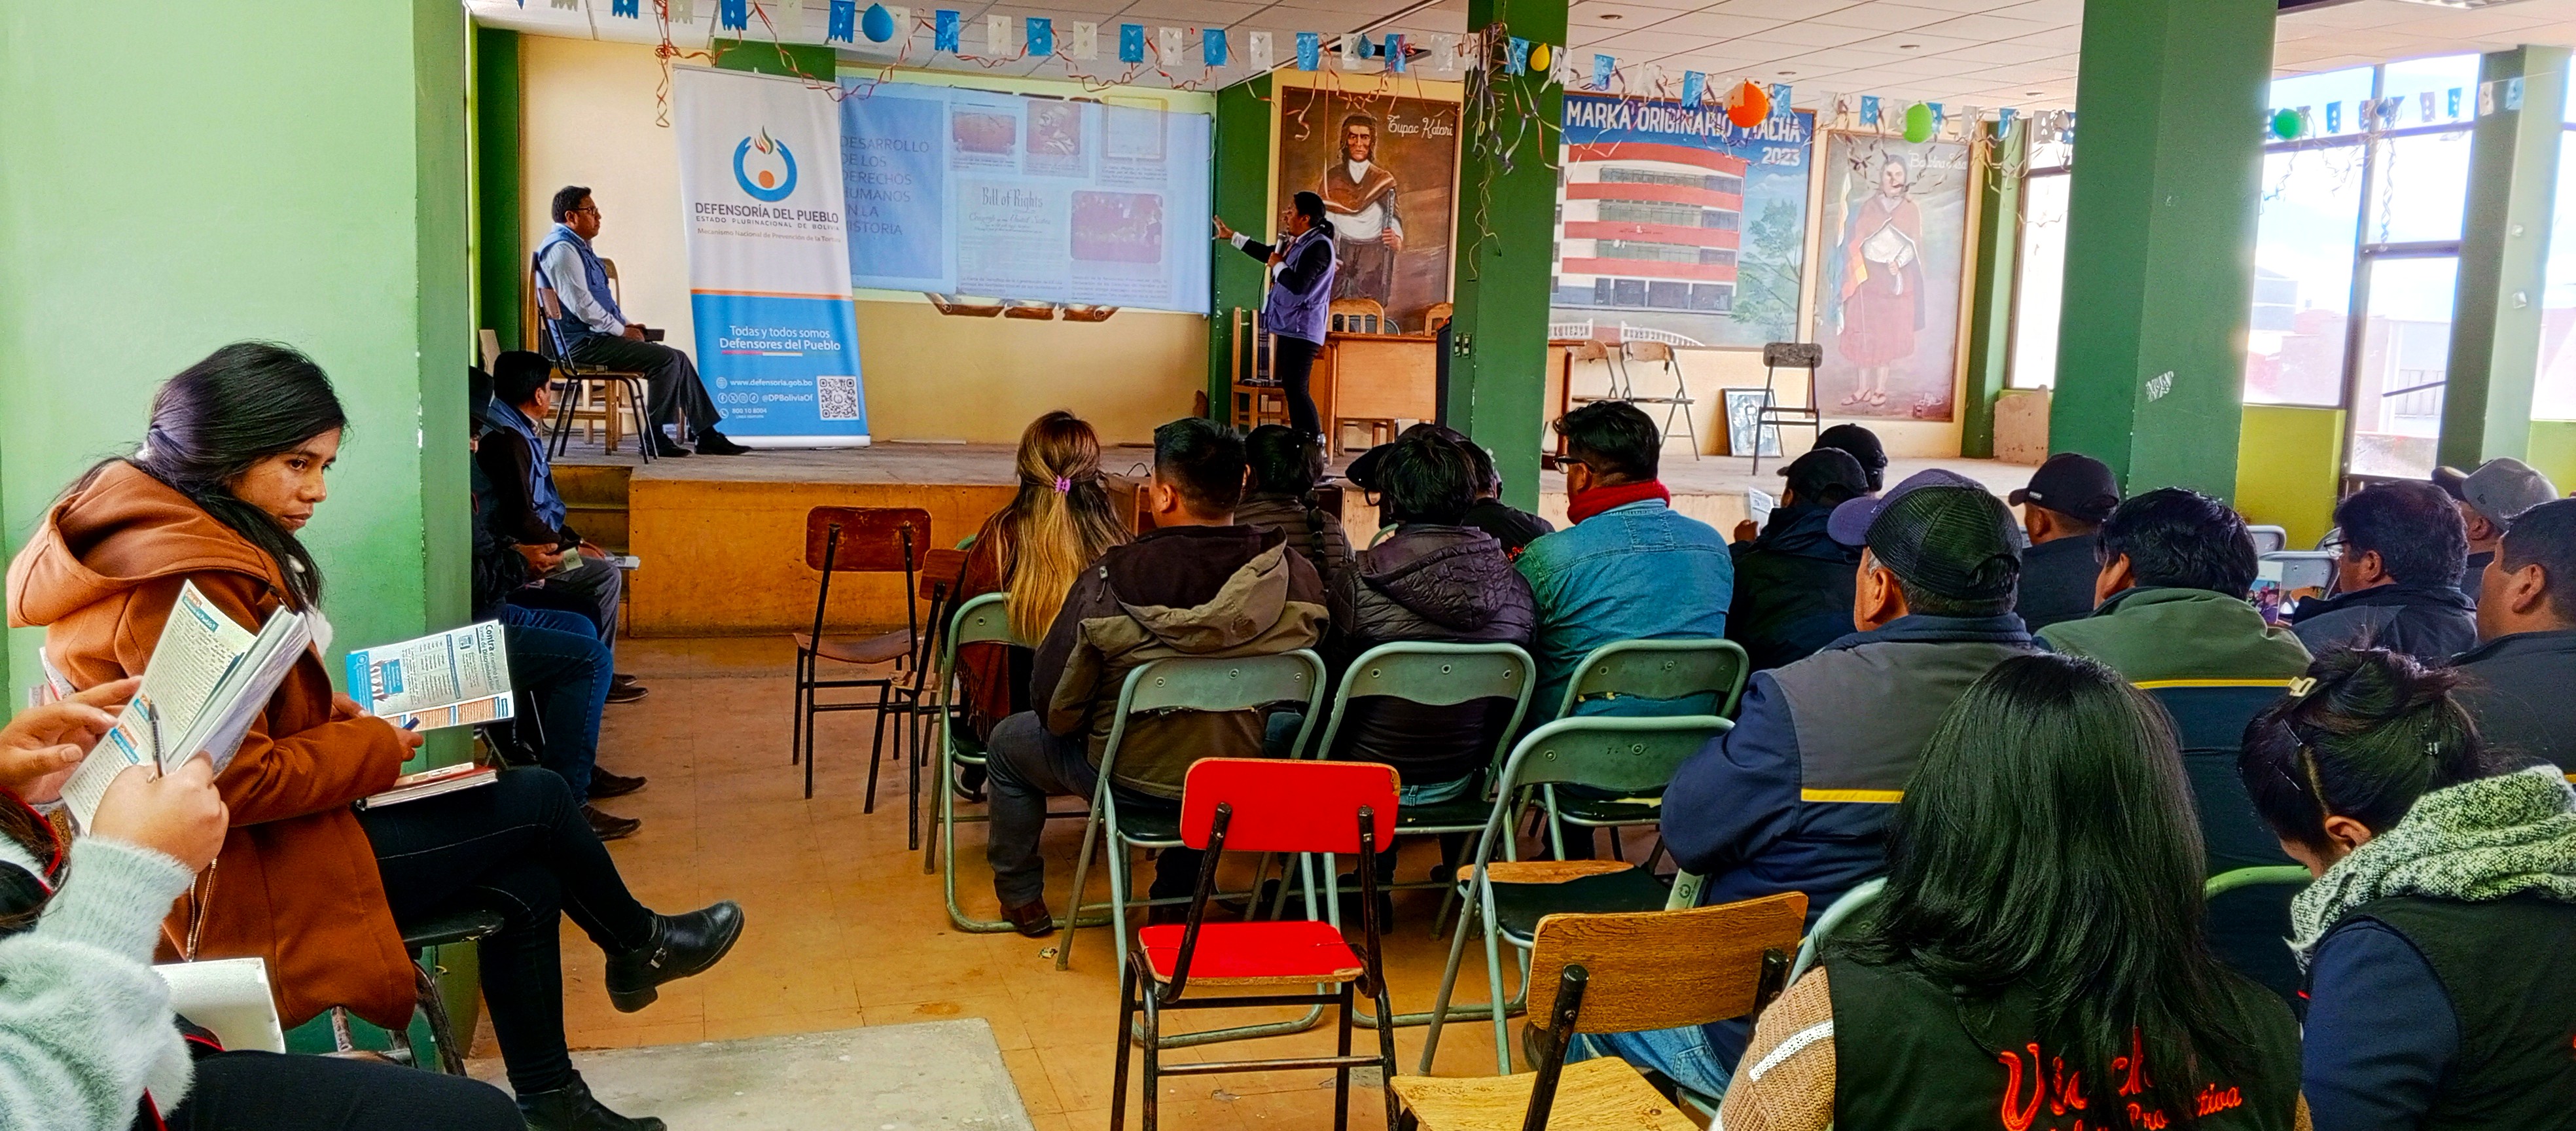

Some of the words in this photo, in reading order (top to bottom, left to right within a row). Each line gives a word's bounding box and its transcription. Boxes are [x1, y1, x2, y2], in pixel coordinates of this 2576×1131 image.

[1387, 115, 1419, 137] Tupac
[1566, 100, 1631, 130] MARKA
[1637, 105, 1732, 139] ORIGINARIO
[841, 136, 929, 153] DESARROLLO
[862, 155, 887, 167] LOS
[1762, 147, 1800, 167] 2023
[982, 187, 998, 206] Bill
[1001, 190, 1011, 207] of
[1014, 188, 1043, 209] Rights
[696, 202, 770, 219] DEFENSORÍA
[773, 208, 795, 221] DEL
[797, 210, 839, 223] PUEBLO
[847, 204, 858, 217] N
[862, 206, 879, 218] LA
[732, 218, 792, 228] PLURINACIONAL
[847, 221, 903, 236] ISTORIA
[730, 325, 759, 337] Todas
[759, 329, 767, 339] y
[769, 327, 797, 338] todos
[799, 329, 831, 338] somos
[720, 338, 783, 350] Defensores
[785, 339, 802, 350] del
[804, 340, 841, 351] Pueblo
[730, 378, 813, 388] www.defensoria.gob.bo
[486, 624, 495, 651] Contra
[482, 649, 495, 691] Discriminación
